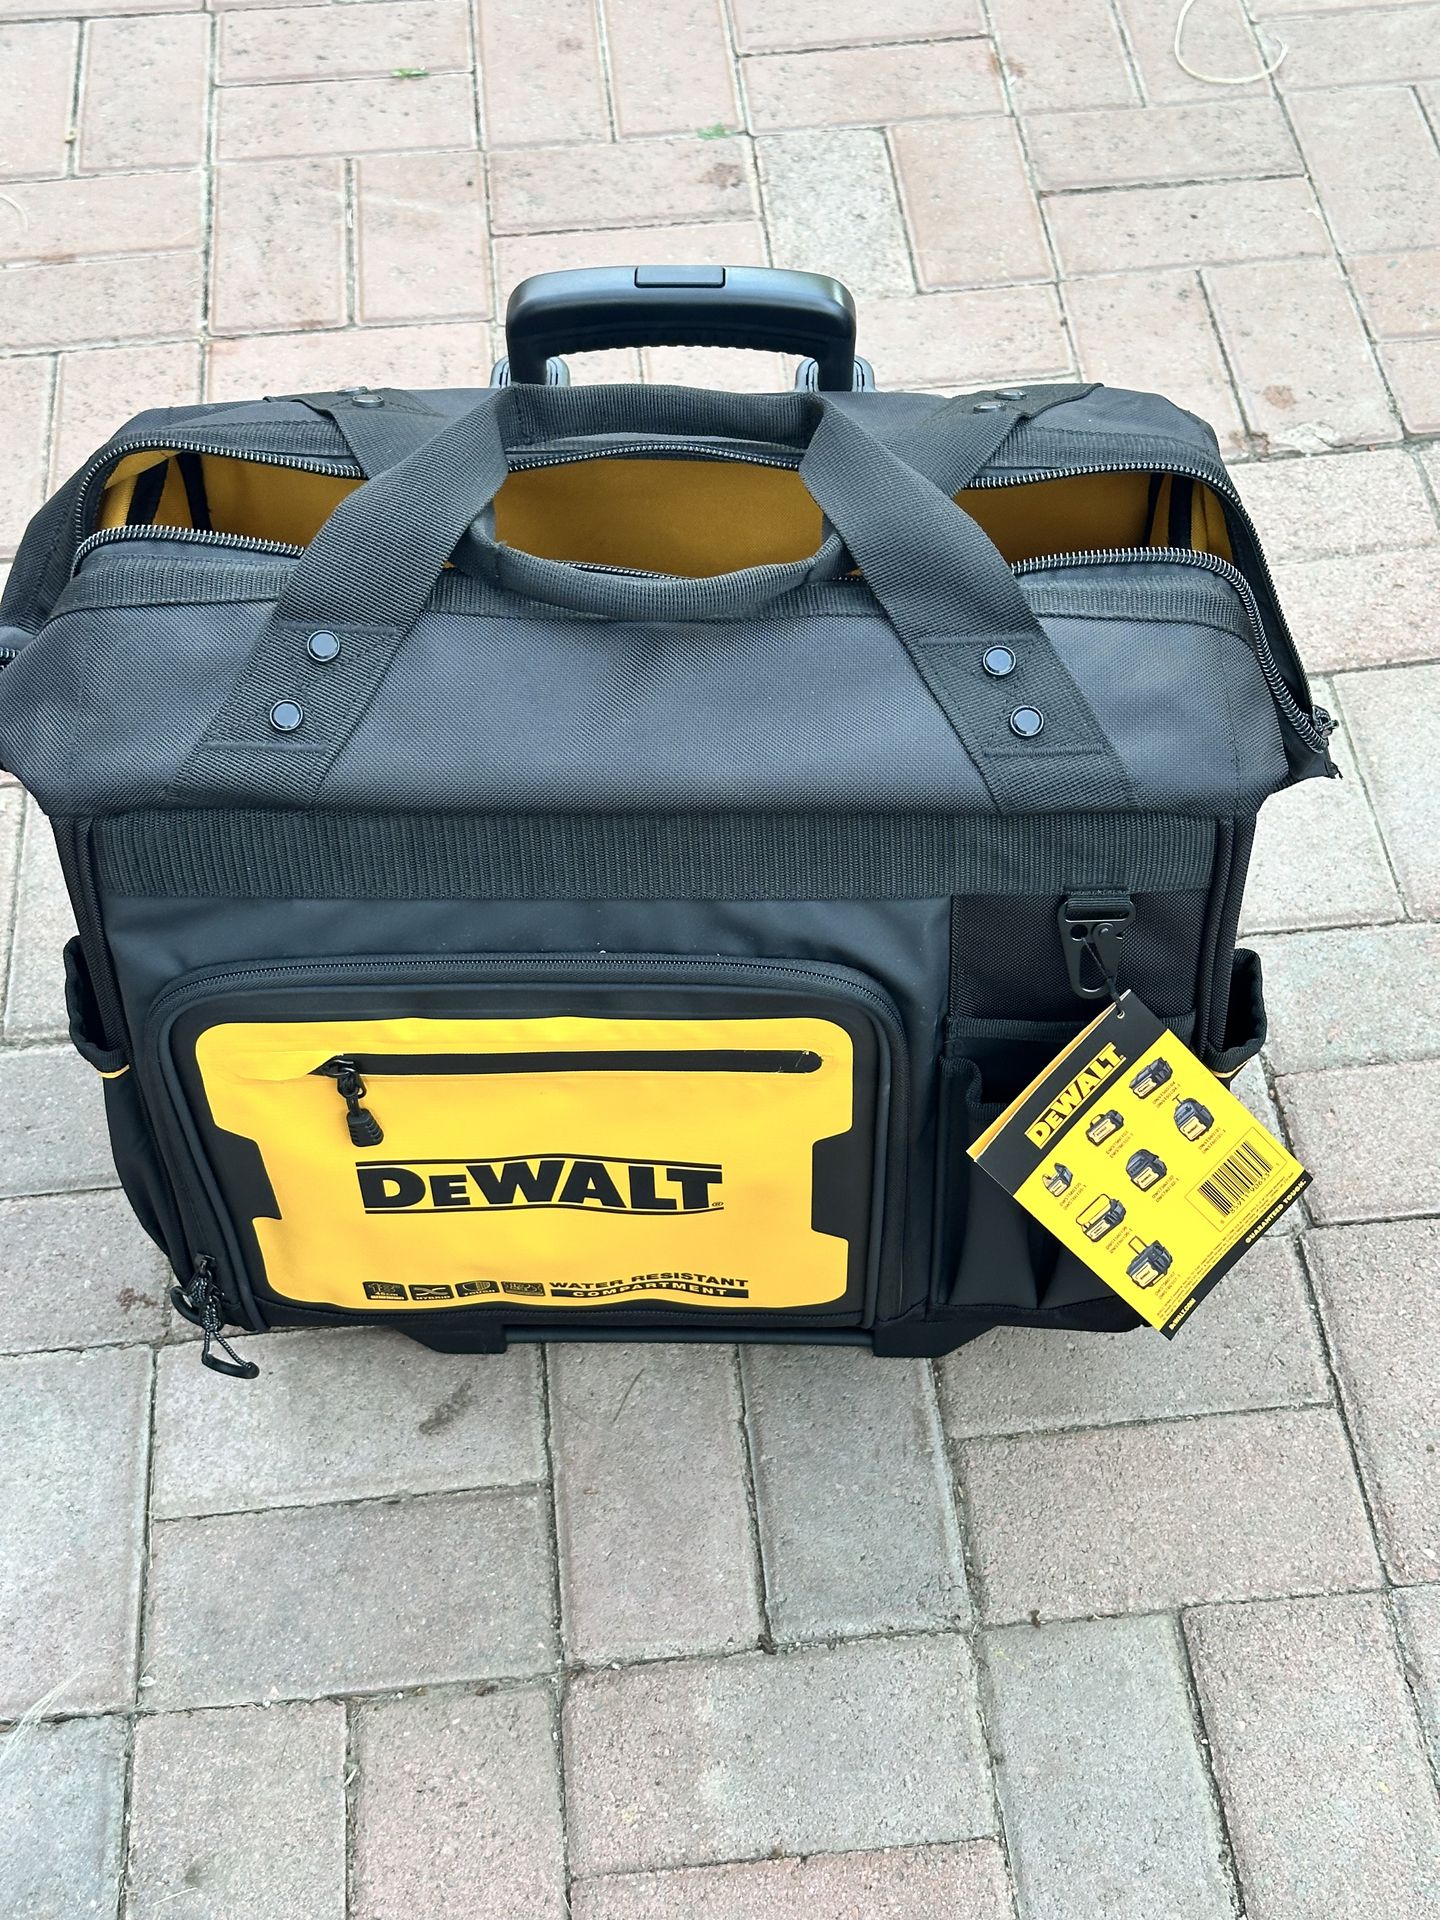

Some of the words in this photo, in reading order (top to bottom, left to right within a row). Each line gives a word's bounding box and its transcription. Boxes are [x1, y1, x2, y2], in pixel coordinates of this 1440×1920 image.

[1244, 1200, 1285, 1245] GUARANTEED
[550, 1279, 624, 1289] WATER
[631, 1272, 749, 1287] RESISTANT
[572, 1281, 728, 1297] COMPARTMENT
